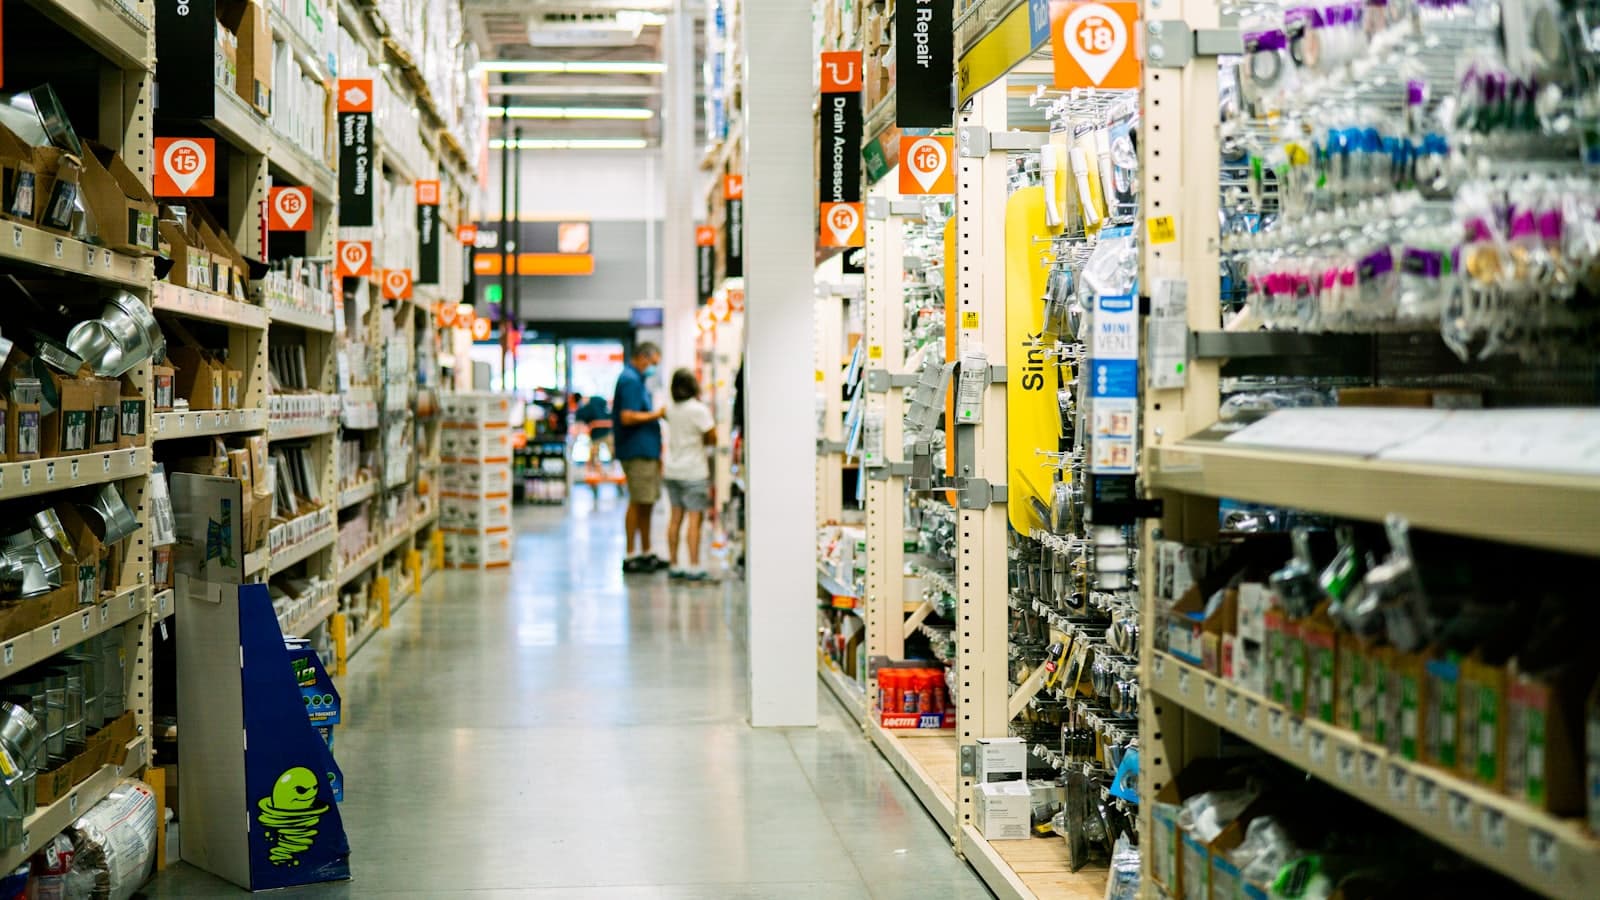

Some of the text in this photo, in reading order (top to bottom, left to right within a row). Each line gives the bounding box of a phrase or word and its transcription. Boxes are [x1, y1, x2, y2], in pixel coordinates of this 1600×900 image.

[913, 8, 933, 68] Repair
[1079, 26, 1113, 50] 18
[833, 97, 846, 134] Drain
[344, 115, 354, 147] Vents
[174, 155, 197, 171] 15
[354, 115, 368, 196] Floor & Ceiling
[916, 153, 938, 169] 16
[282, 199, 300, 213] 13
[834, 215, 853, 228] 14
[1102, 323, 1130, 334] MINI
[1098, 336, 1133, 351] VENT
[1021, 333, 1045, 391] Sink
[883, 717, 917, 727] LOCTITE
